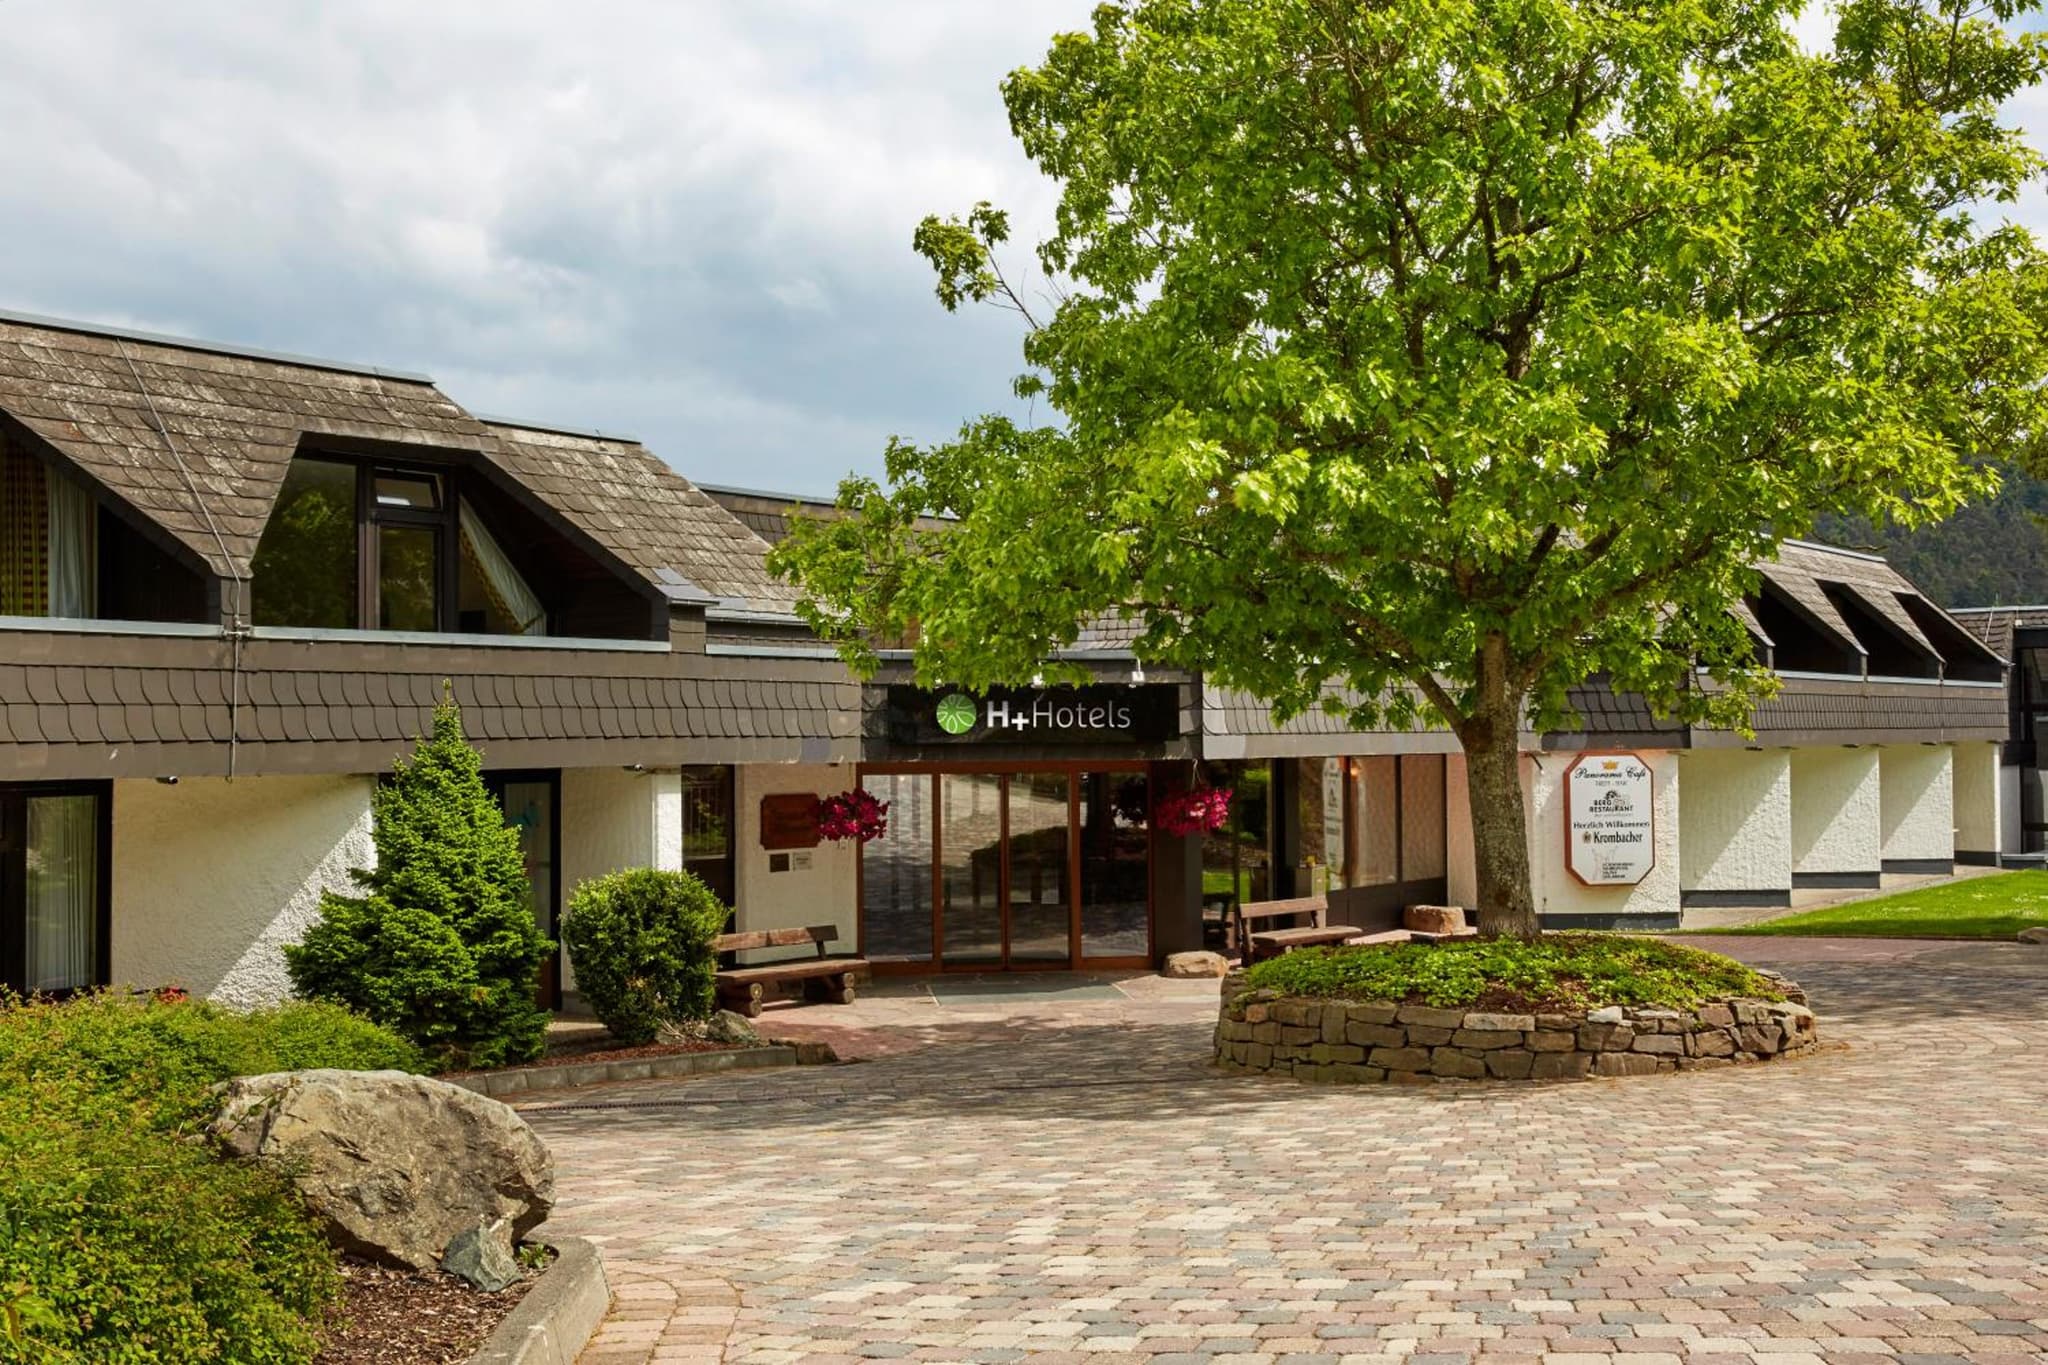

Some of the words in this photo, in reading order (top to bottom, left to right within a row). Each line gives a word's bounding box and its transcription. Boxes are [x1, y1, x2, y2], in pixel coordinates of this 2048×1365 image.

[1574, 767, 1622, 779] Panorama
[1573, 821, 1604, 829] Herzlich
[1605, 820, 1650, 828] Willkommen
[1593, 831, 1642, 843] Krombacher
